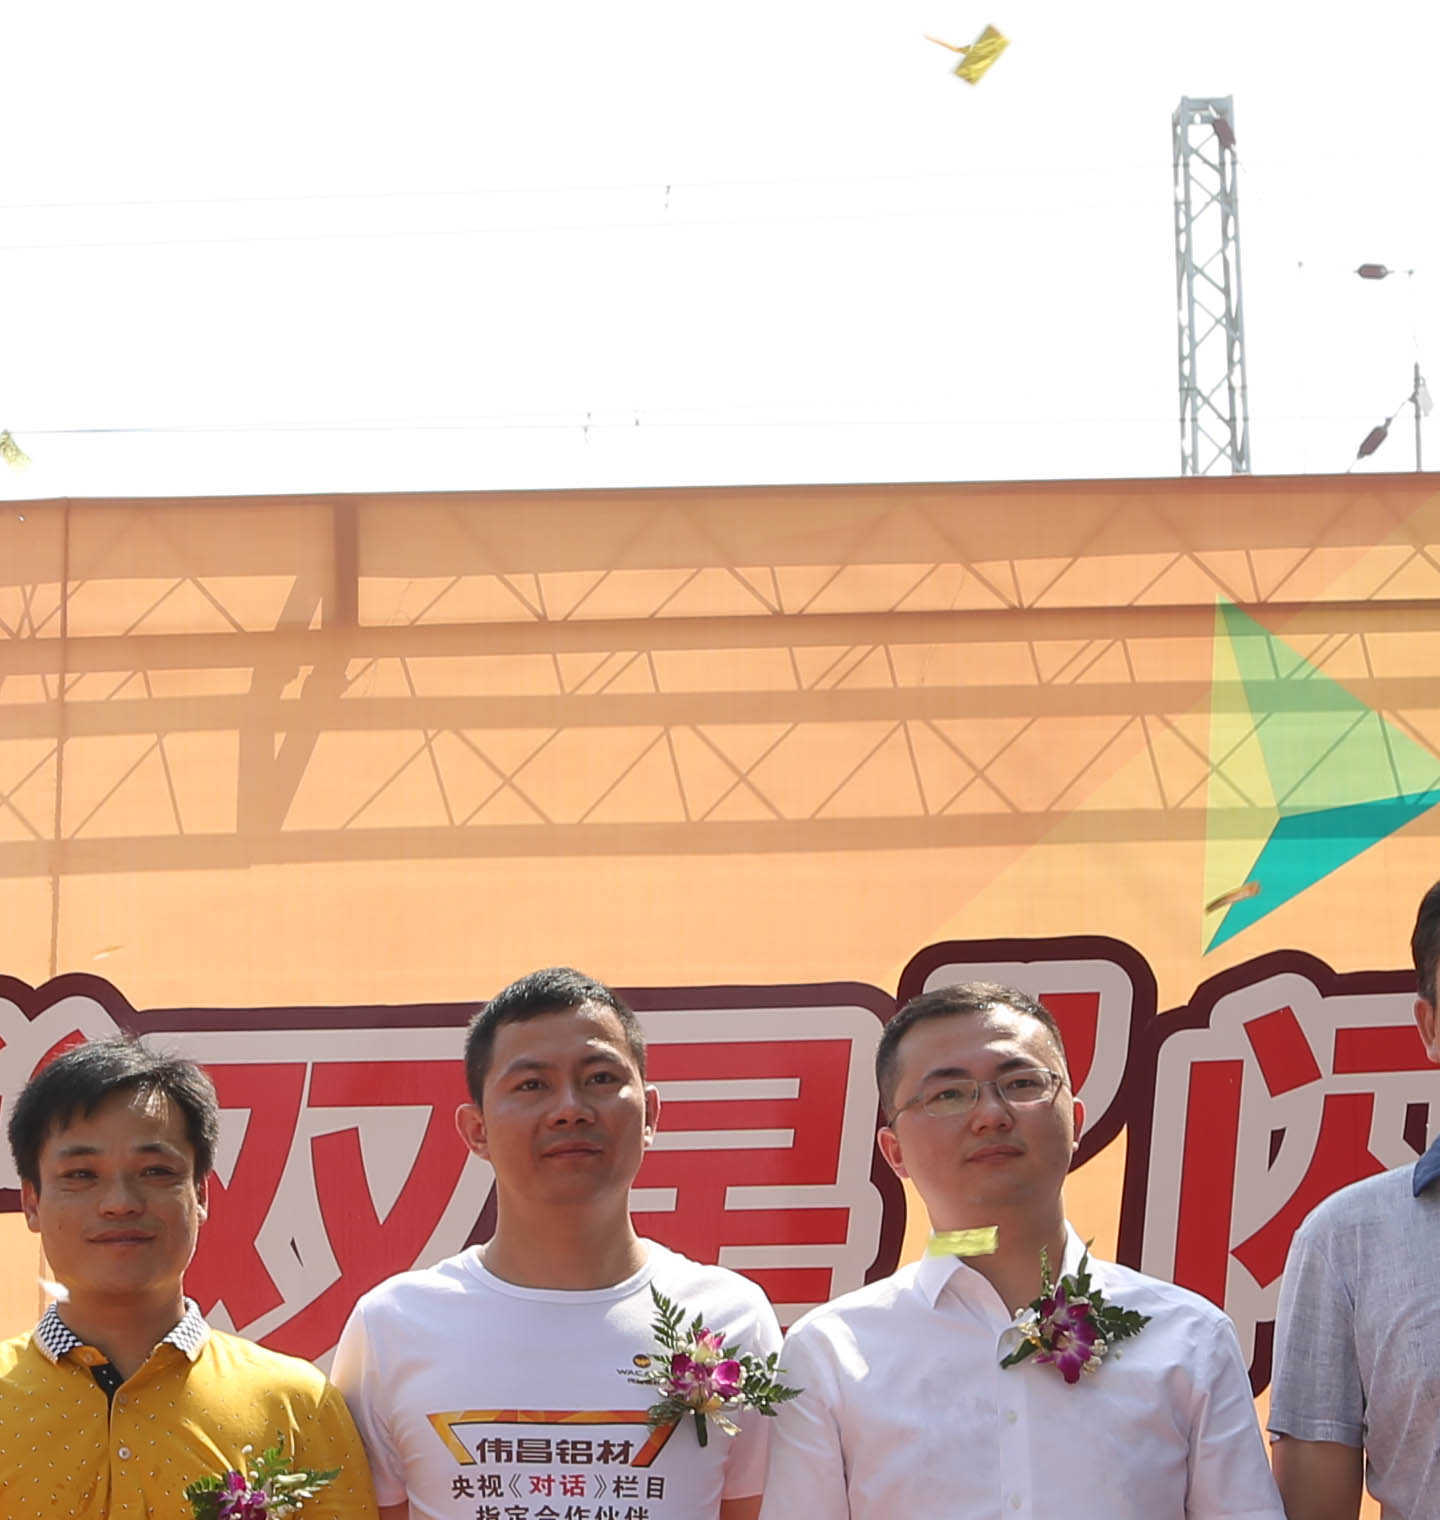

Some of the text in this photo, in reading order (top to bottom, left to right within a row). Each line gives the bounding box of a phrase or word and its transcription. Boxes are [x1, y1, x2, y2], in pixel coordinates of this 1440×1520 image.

[475, 1438, 634, 1465] 伟昌铝材
[450, 1473, 666, 1500] 央视《对话》栏目
